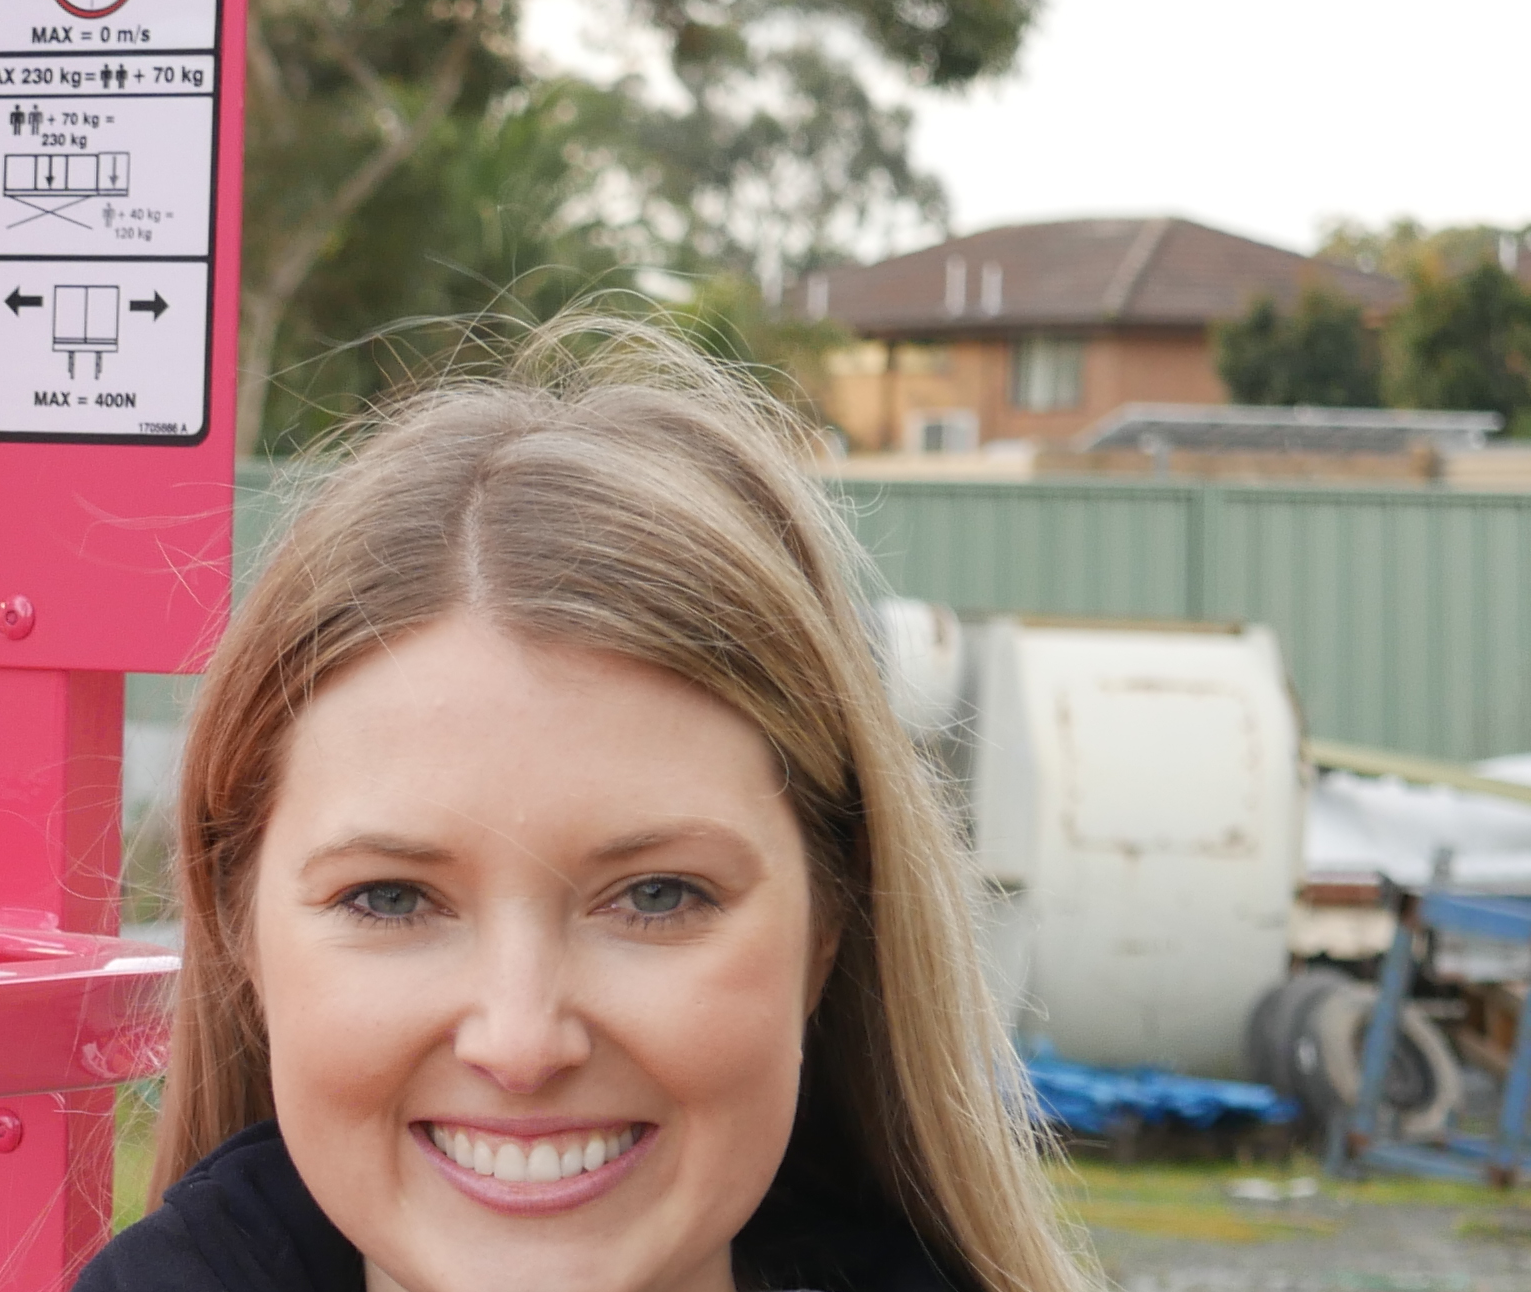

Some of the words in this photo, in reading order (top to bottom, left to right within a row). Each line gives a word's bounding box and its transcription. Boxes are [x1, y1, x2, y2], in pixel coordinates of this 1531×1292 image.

[32, 26, 72, 44] MAX
[100, 26, 111, 43] 0
[117, 24, 151, 44] m/s
[21, 67, 54, 85] 230
[153, 66, 175, 84] 70
[182, 65, 204, 87] kg
[62, 112, 78, 126] 70
[83, 111, 100, 128] kg
[41, 132, 66, 147] 230
[71, 131, 87, 149] kg
[130, 208, 145, 220] 40
[147, 207, 161, 223] kg
[115, 226, 135, 239] 120
[138, 226, 153, 242] kg
[34, 390, 71, 408] MAX
[94, 391, 137, 409] 400N
